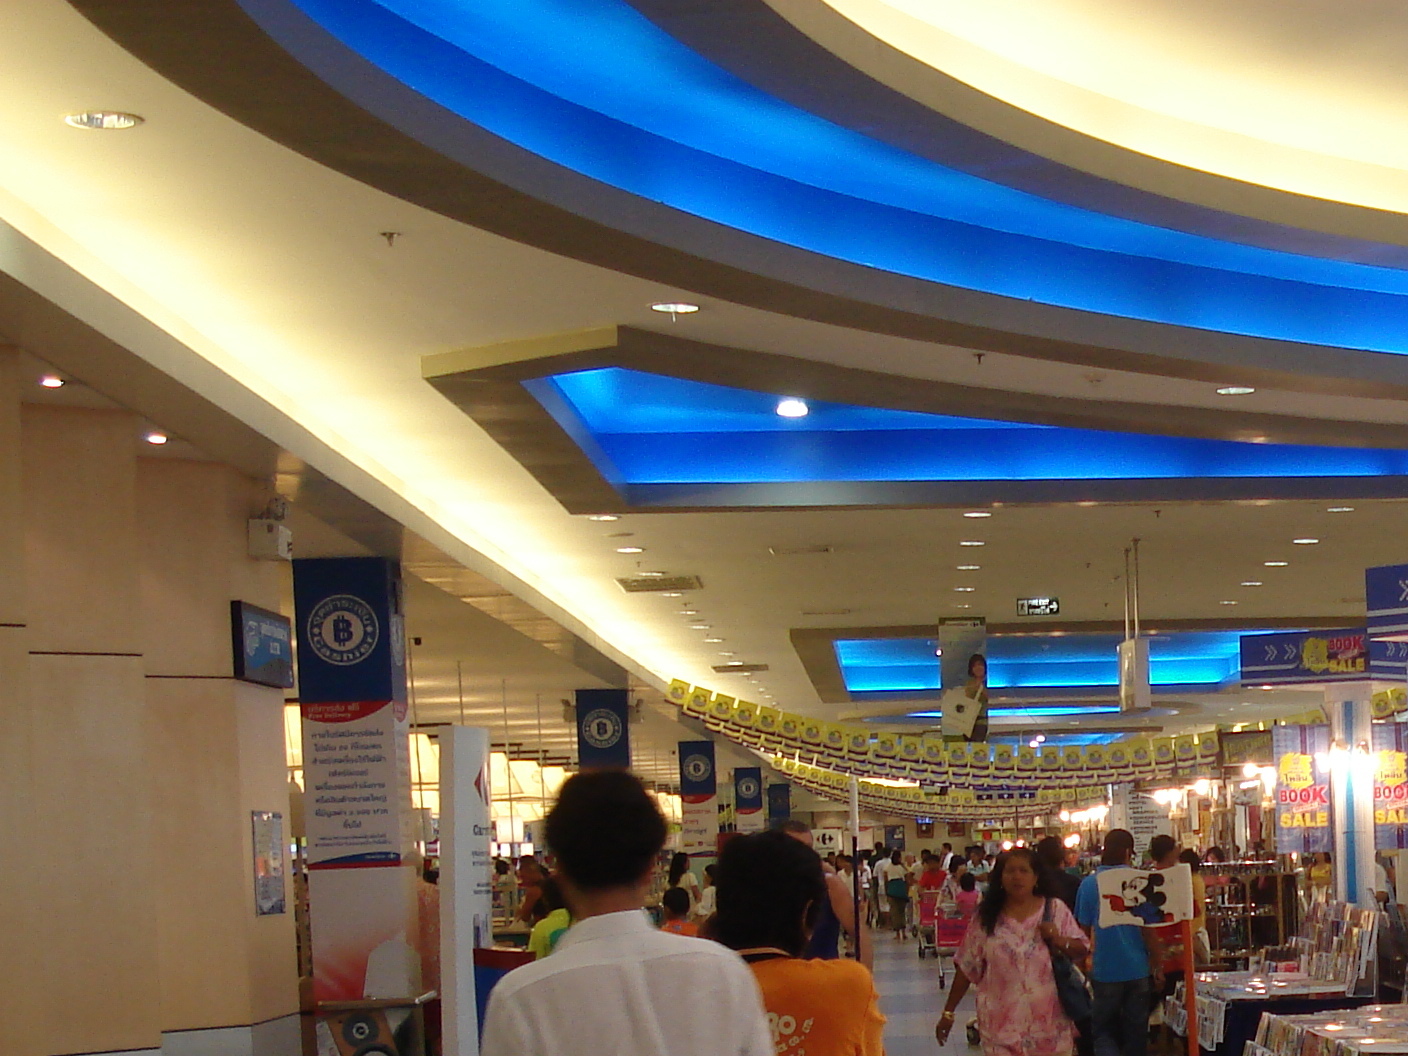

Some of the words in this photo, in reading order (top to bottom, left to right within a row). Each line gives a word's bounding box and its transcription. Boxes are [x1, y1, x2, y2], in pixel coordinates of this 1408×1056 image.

[1328, 635, 1364, 651] BOOK
[1328, 658, 1365, 673] SALE
[1279, 786, 1328, 804] BOOK
[1280, 812, 1329, 828] SALE
